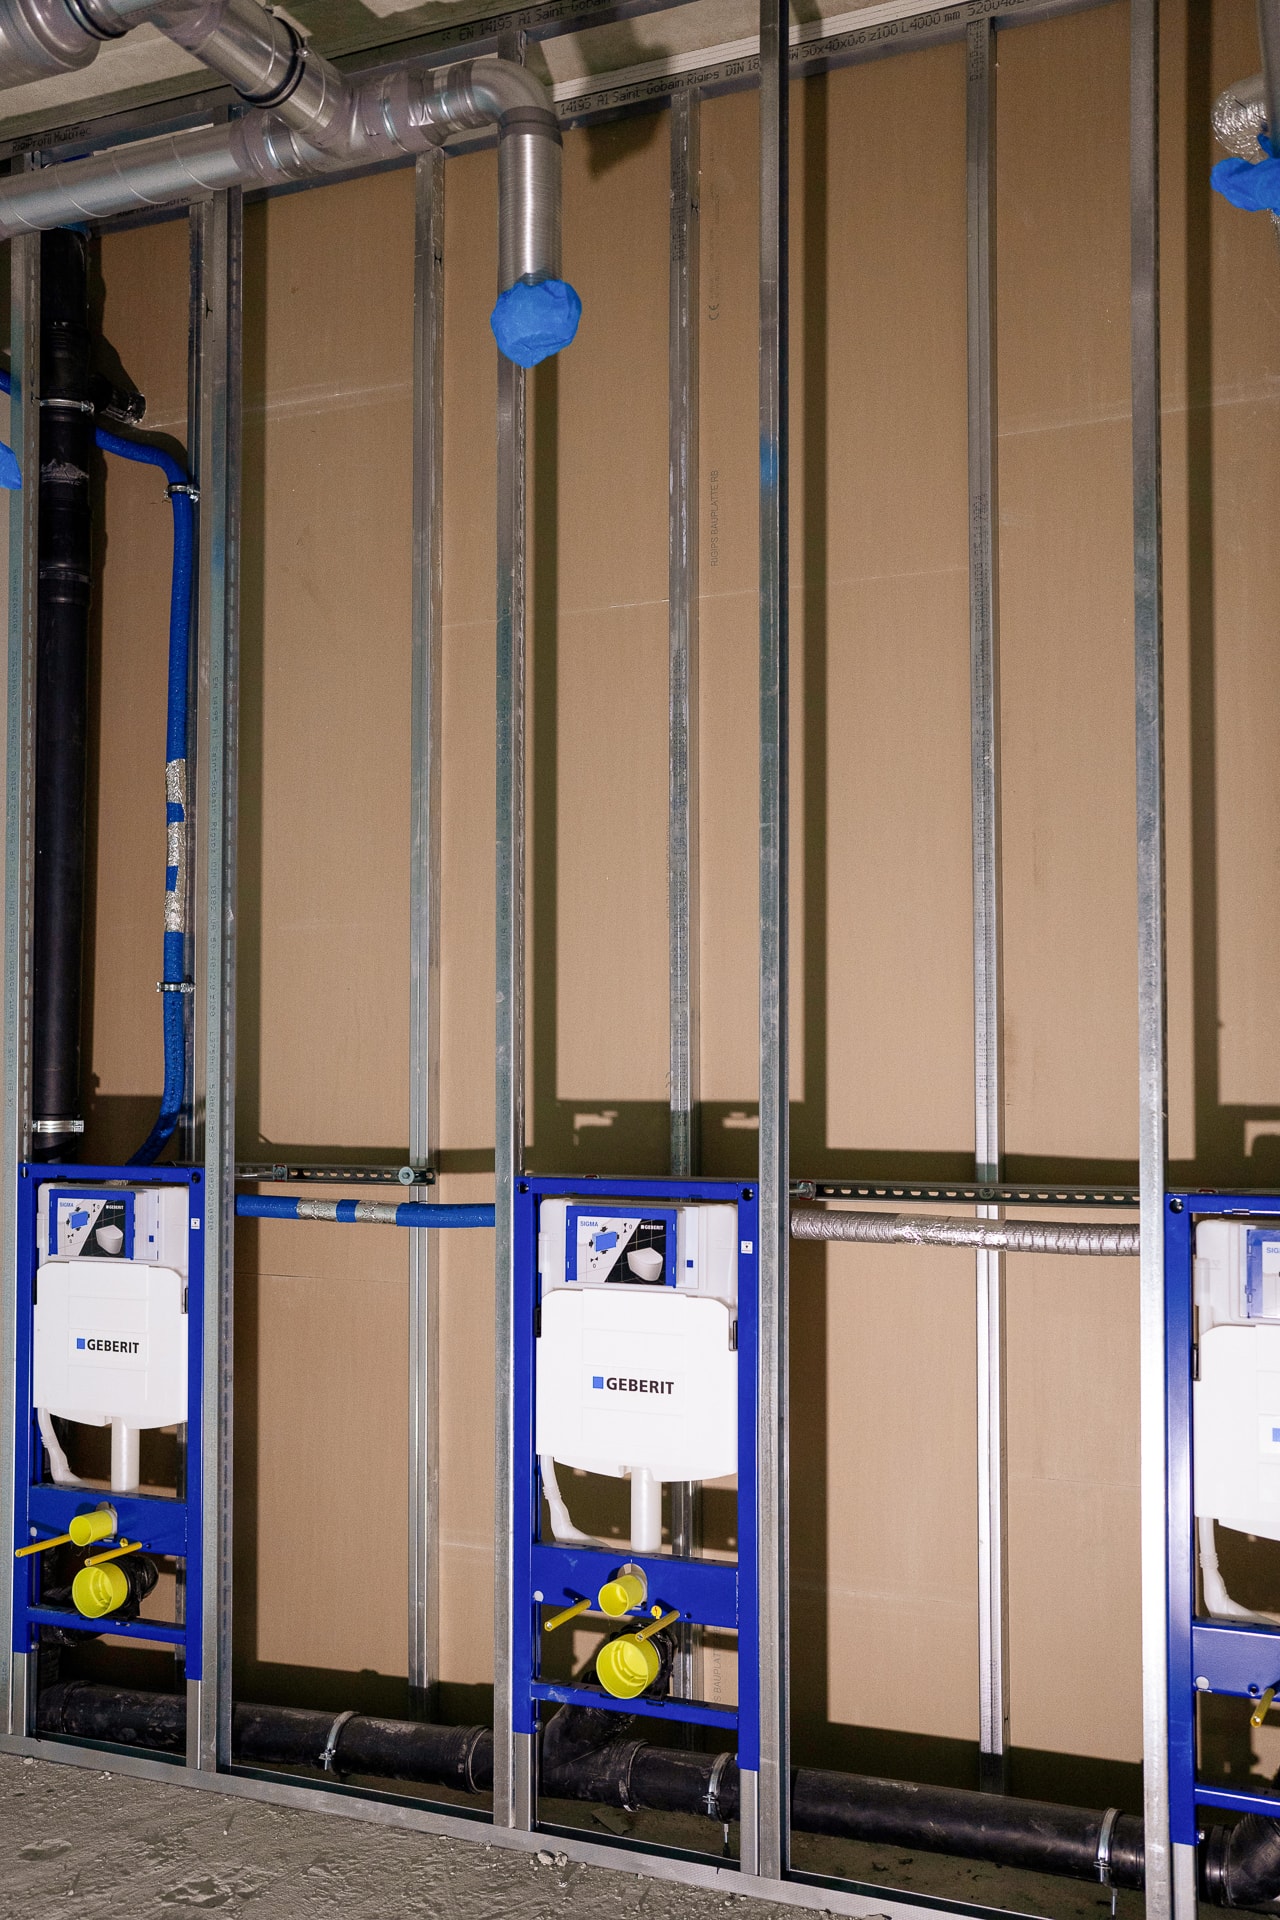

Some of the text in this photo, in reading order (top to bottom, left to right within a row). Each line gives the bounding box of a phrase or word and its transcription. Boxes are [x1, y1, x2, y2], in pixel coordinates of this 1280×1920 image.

[612, 78, 685, 104] Saint-Gobain
[686, 69, 720, 85] Rigips
[710, 483, 719, 535] BAUPLATTE
[710, 537, 719, 567] RIGIPS
[87, 1339, 139, 1353] GEBERIT
[606, 1377, 675, 1394] GEBERIT
